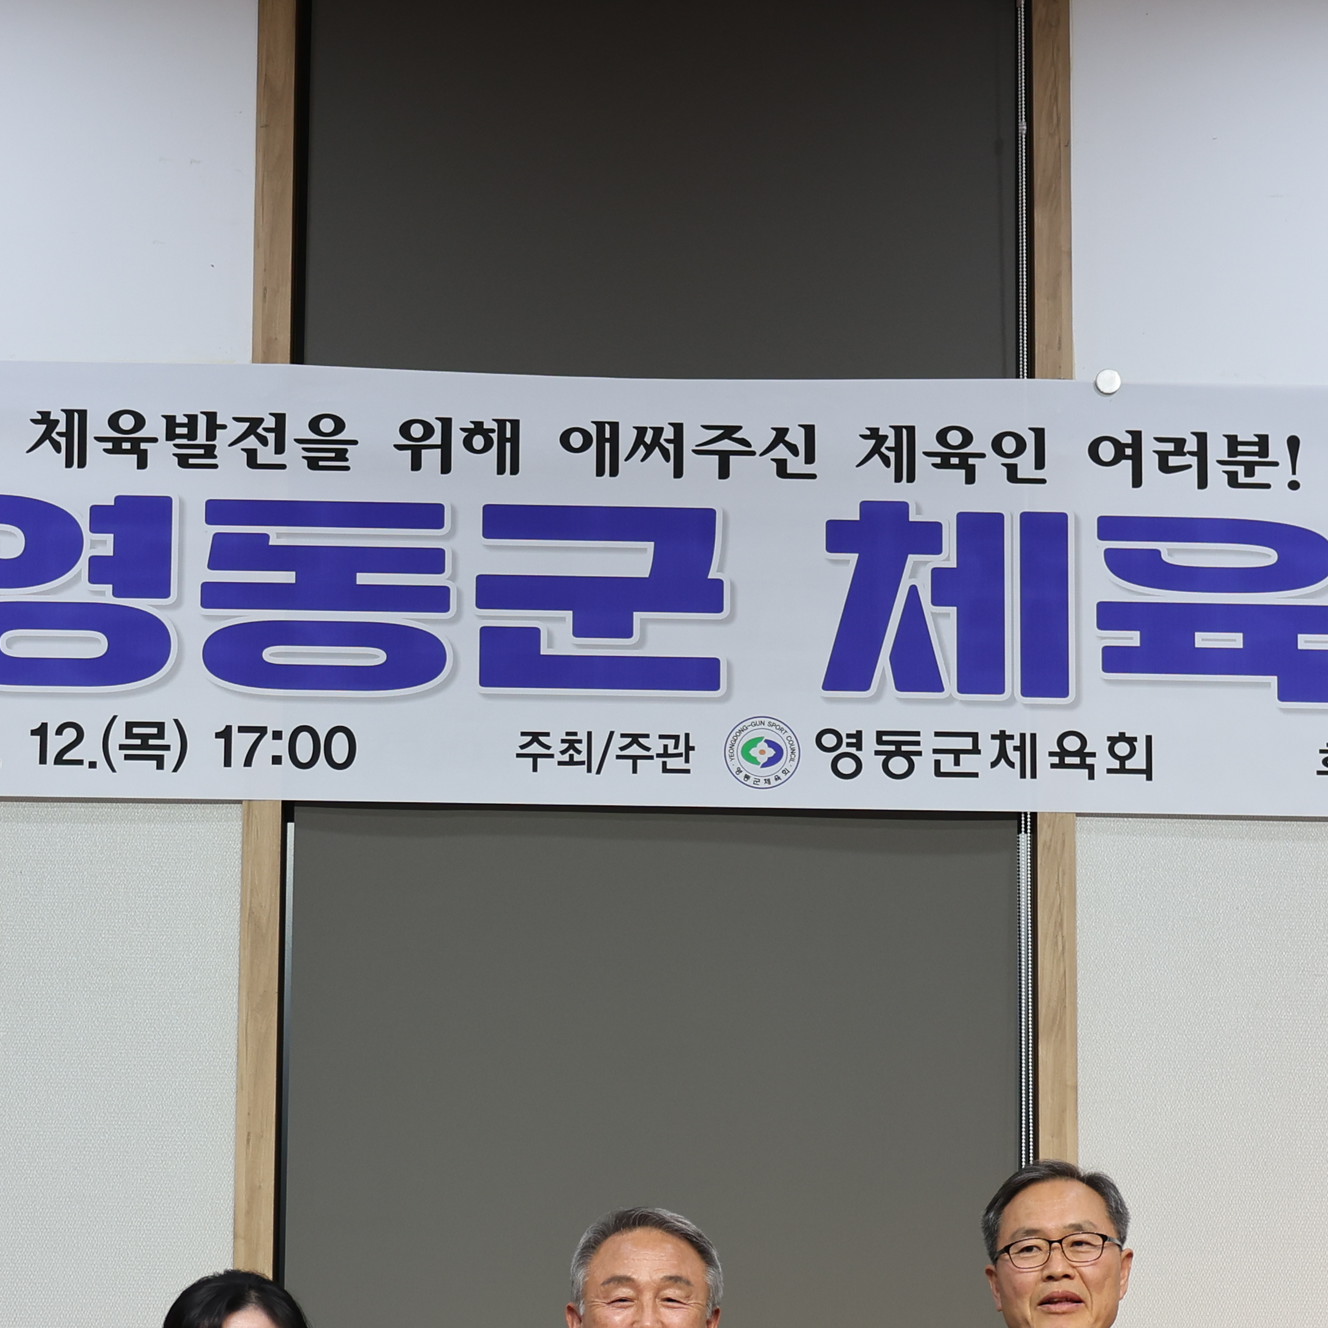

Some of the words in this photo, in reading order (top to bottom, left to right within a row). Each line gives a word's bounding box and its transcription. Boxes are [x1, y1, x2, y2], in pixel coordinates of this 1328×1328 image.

[26, 409, 358, 474] 체육발전을
[393, 417, 520, 475] 위해
[560, 421, 817, 481] 애써주신
[856, 426, 1048, 484] 체육인
[1088, 430, 1301, 490] 여러분!
[31, 715, 188, 773] 12.(목)
[215, 725, 357, 771] 17:00
[516, 731, 695, 775] 주최/주관
[814, 729, 1154, 782] 영동군체육회
[729, 720, 766, 762] YEONGDONG-GUN
[767, 721, 788, 735] SPORT
[786, 735, 797, 763] COUNCIL
